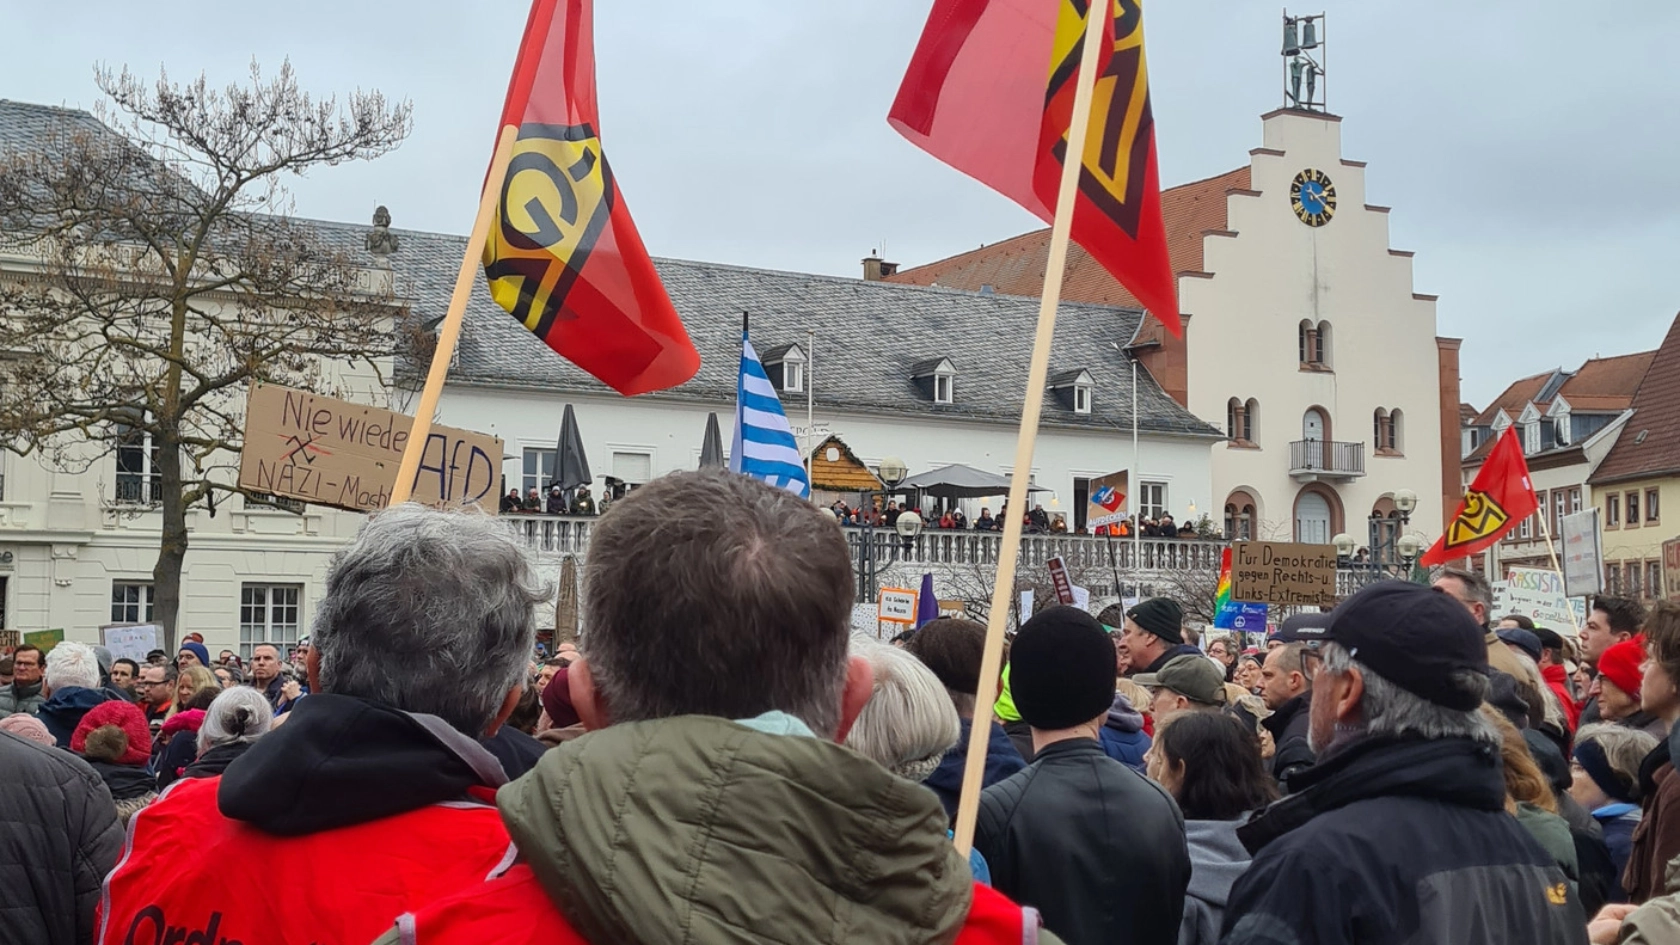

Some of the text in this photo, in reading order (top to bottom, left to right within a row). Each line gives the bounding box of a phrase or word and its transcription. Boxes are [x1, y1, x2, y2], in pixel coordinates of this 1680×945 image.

[282, 391, 409, 453] Nie wiede
[411, 434, 493, 505] AfD
[1239, 570, 1269, 583] gegen
[1263, 545, 1336, 569] Demokratie
